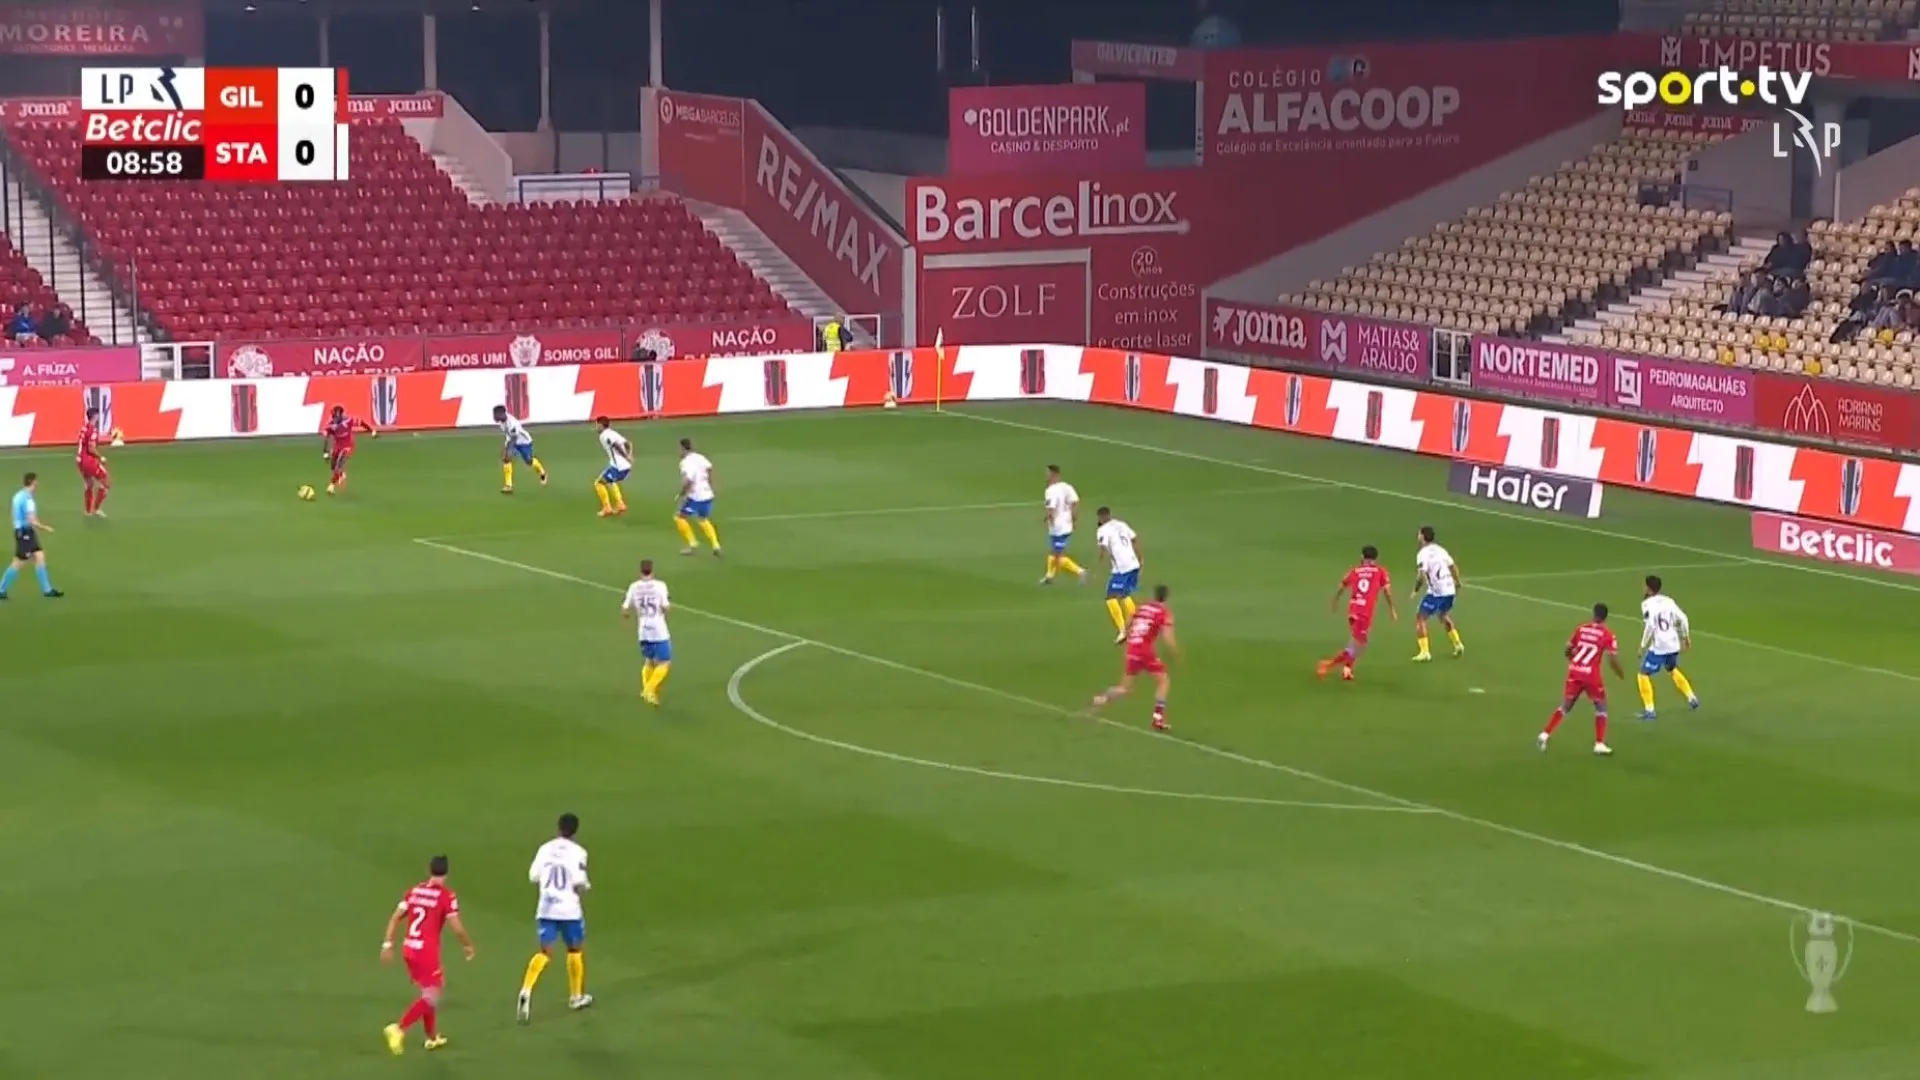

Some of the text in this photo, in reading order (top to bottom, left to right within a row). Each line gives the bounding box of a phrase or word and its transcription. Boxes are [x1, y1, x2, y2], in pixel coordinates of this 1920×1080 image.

[0, 24, 149, 43] MOREIRA
[1699, 37, 1832, 77] IMPETUS
[1228, 65, 1321, 88] COLÉGIO
[1218, 86, 1460, 135] ALFACOOP
[990, 140, 1031, 153] CASINO
[1043, 138, 1099, 152] DESPORTO
[1136, 251, 1154, 266] 20
[952, 284, 1056, 320] ZOLF
[1098, 281, 1196, 301] Construções
[1115, 307, 1178, 325] em inox
[712, 325, 776, 348] NAÇÃO
[1111, 334, 1153, 349] corte
[1157, 329, 1193, 347] laser
[314, 342, 385, 367] NAÇÃO
[430, 347, 619, 368] SOMOS UM! SOMOS GIL!
[1479, 342, 1599, 385] NORTEMED
[1671, 395, 1724, 414] ARQUITECTO
[1837, 398, 1884, 417] ADRIANA
[1838, 415, 1882, 433] MARTINS
[1469, 466, 1569, 511] Haier
[1780, 521, 1894, 567] Betclic
[1573, 639, 1599, 665] 77
[543, 862, 568, 891] 70
[409, 906, 426, 938] 2
